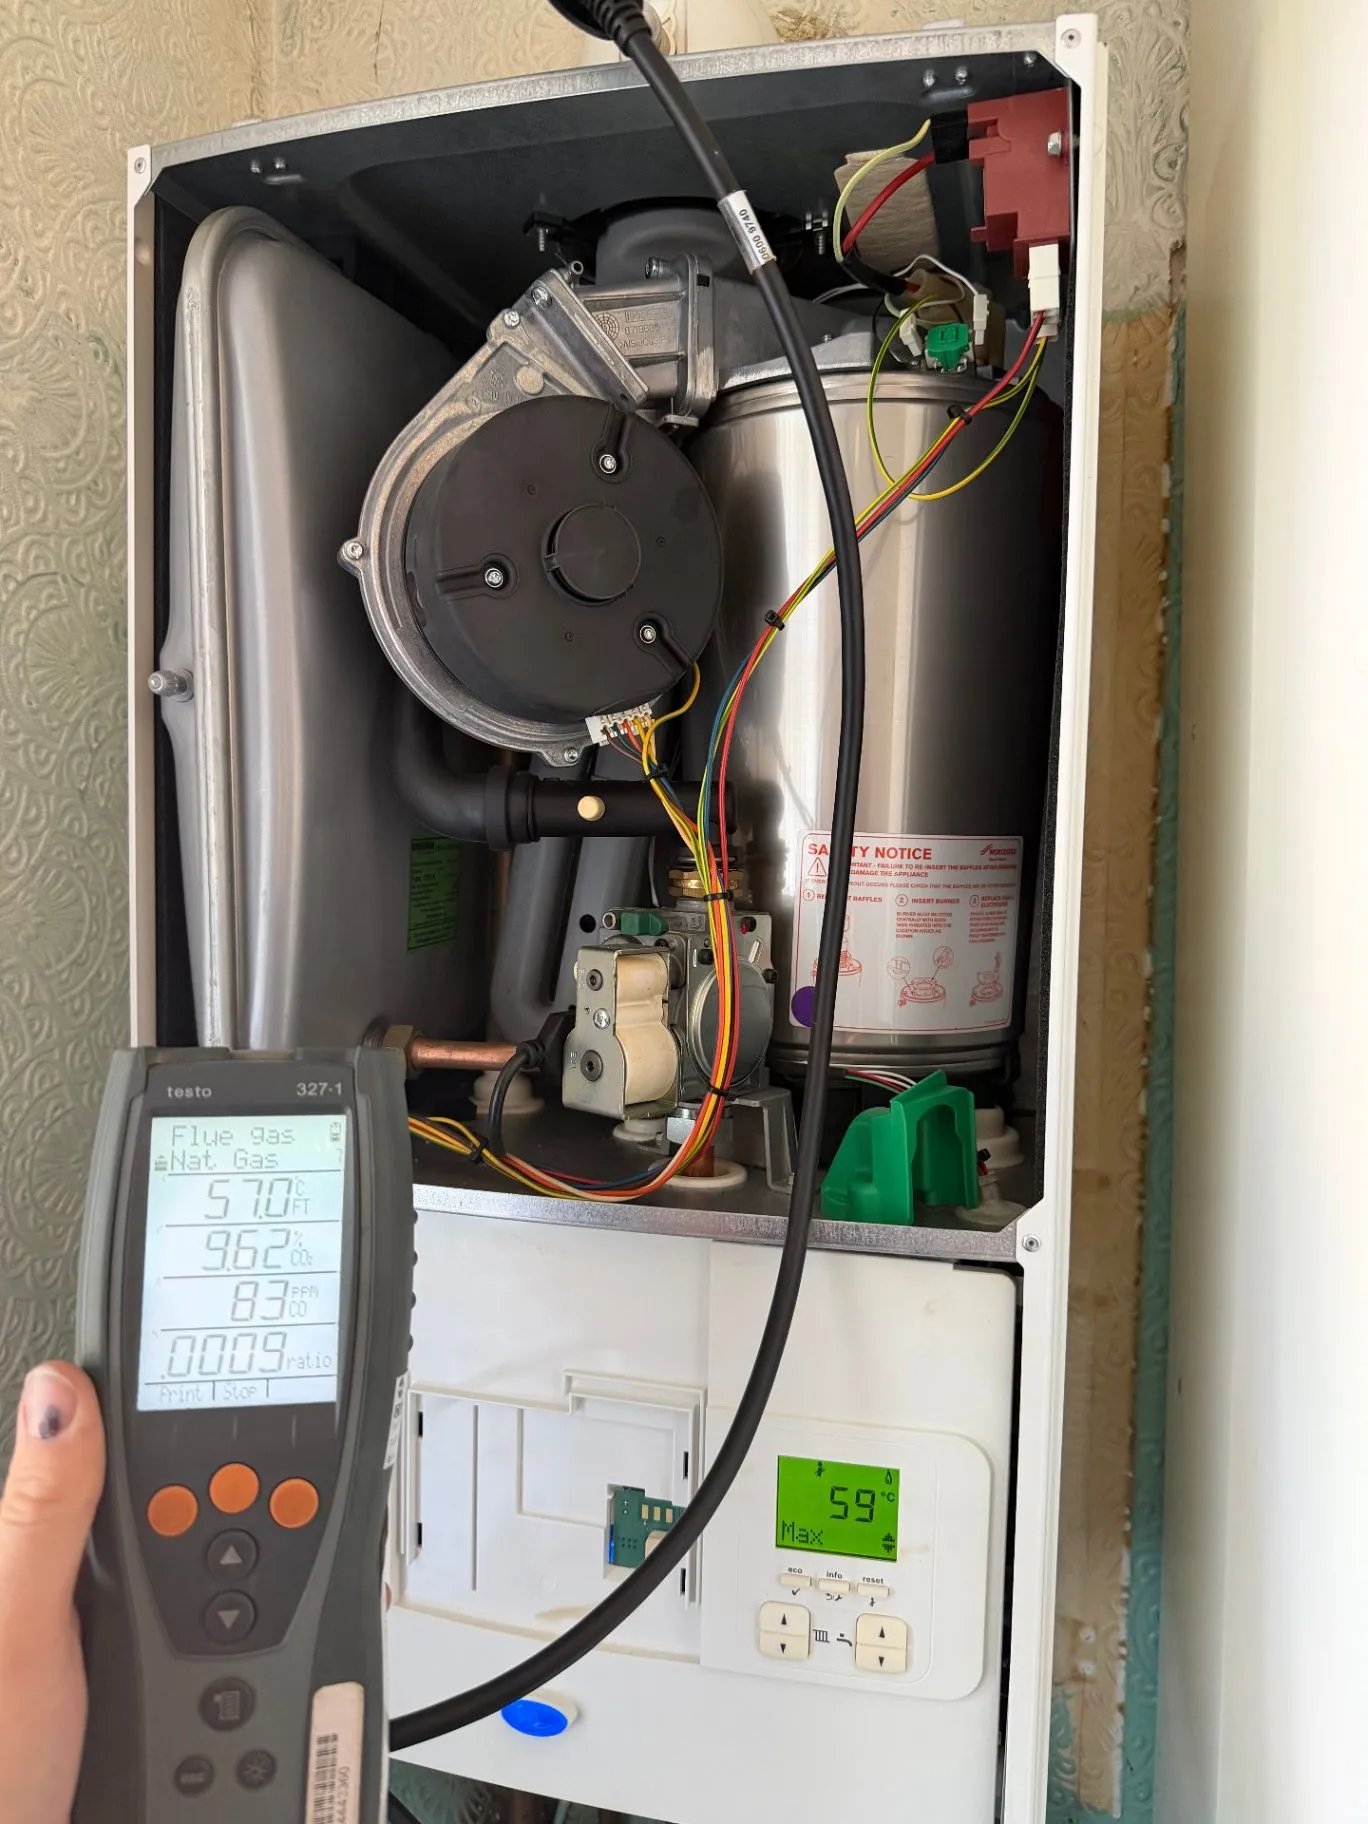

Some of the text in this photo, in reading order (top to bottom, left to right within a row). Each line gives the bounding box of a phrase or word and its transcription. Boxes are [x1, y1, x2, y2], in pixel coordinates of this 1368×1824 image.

[739, 208, 757, 234] 9740
[808, 843, 932, 860] SATY NOTICE
[167, 1085, 212, 1098] testo
[296, 1082, 343, 1097] 327-1
[172, 1125, 295, 1147] Flue gas
[233, 1148, 279, 1169] Gas
[204, 1178, 294, 1220] 57.0
[201, 1228, 291, 1271] 9.62
[230, 1280, 290, 1322] 83
[288, 1301, 307, 1318] CO
[160, 1331, 332, 1380] .0009 ratio
[829, 1485, 896, 1524] 59 °C
[781, 1520, 824, 1546] Max
[787, 1566, 884, 1585] eco info reset
